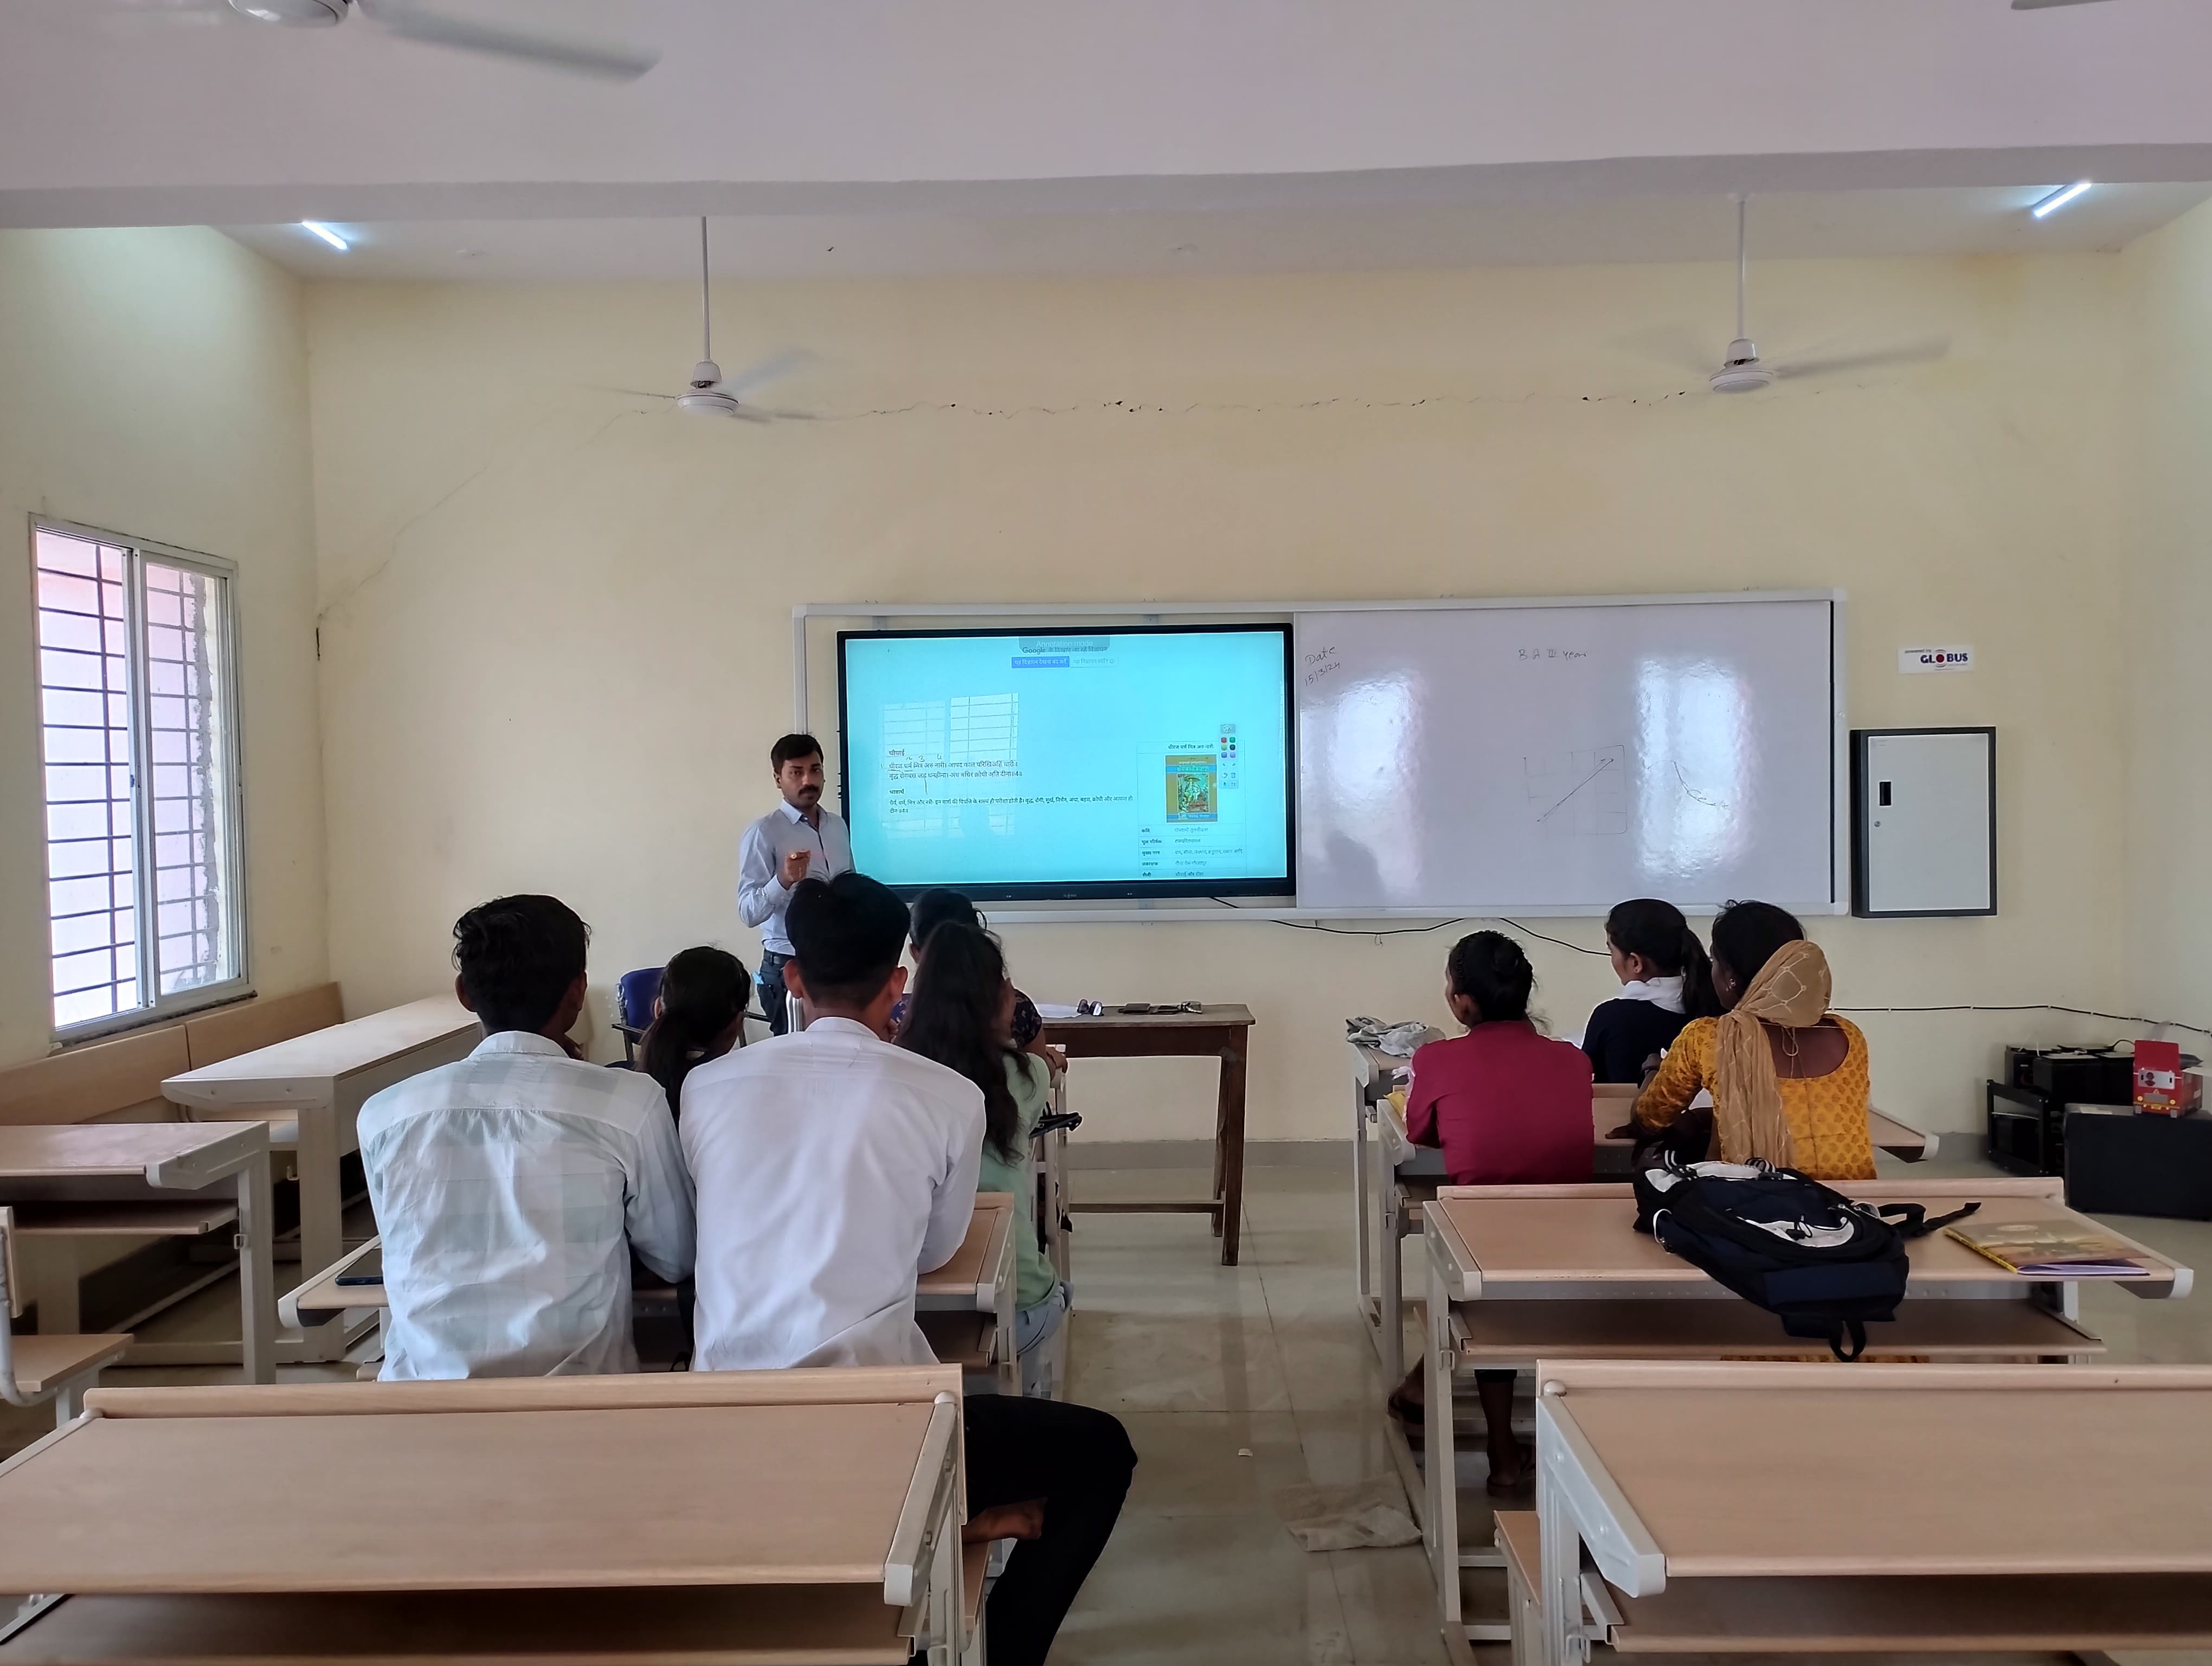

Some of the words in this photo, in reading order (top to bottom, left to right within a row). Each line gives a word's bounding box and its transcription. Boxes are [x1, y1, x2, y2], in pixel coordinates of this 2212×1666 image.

[1305, 646, 1336, 664] Date
[1920, 653, 1968, 663] GLOBUS
[1304, 662, 1340, 686] 15/3/24
